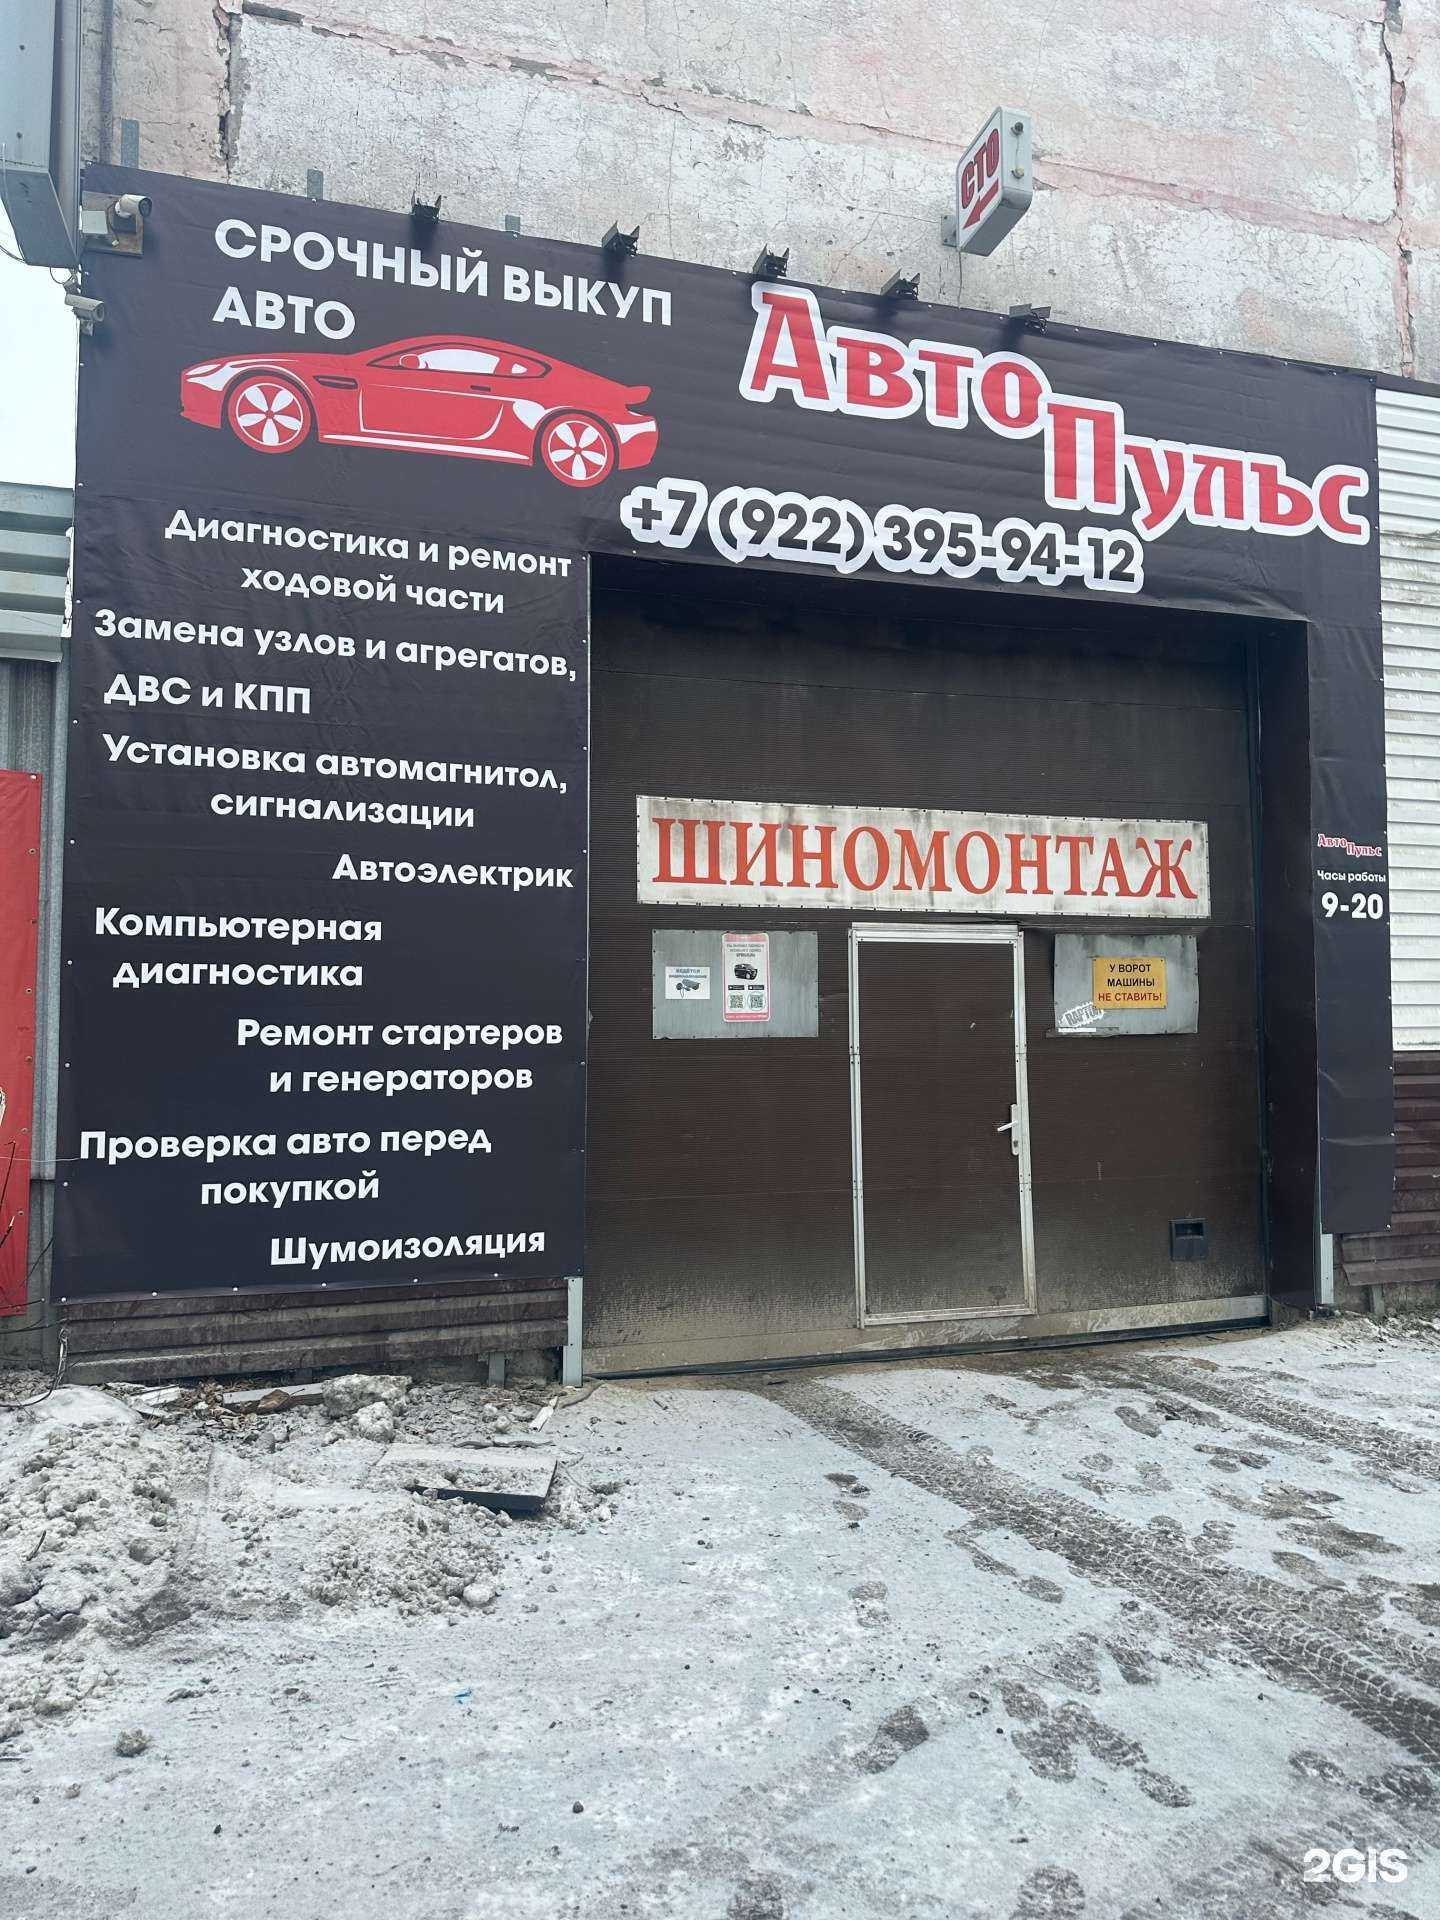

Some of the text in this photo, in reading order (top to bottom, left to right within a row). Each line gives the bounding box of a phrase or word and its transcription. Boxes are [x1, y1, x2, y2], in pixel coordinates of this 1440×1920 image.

[960, 128, 1000, 210] СТО
[214, 218, 672, 326] СРОЧНЫЙ ВЫКУП
[212, 286, 356, 340] АВТО
[164, 509, 572, 577] Диагностика и ремонт
[240, 567, 504, 614] ходовой части
[94, 608, 576, 682] Замена узлов и агрегатов,
[103, 673, 311, 714] ДВС и КПП
[105, 733, 567, 794] Установка автомагнитол,
[210, 793, 474, 830] сигнализации
[331, 853, 574, 892] Автоэлектрик
[651, 817, 1198, 899] ШИНОМОНТАЖ
[1316, 870, 1387, 883] Часы работы
[1320, 891, 1384, 920] 9-20
[95, 907, 382, 946] Компьютерная
[112, 962, 363, 990] диагностика
[1107, 978, 1155, 987] МАШИНЫ
[1109, 963, 1151, 973] У ВОРОТ
[1098, 991, 1162, 1001] НЕ СТАВИТЬ!
[237, 1018, 563, 1051] Ремонт стартеров
[270, 1068, 533, 1097] и генераторов
[80, 1129, 492, 1165] Проверка авто перед
[201, 1169, 379, 1209] покупкой
[270, 1231, 545, 1270] Шумоизоляция
